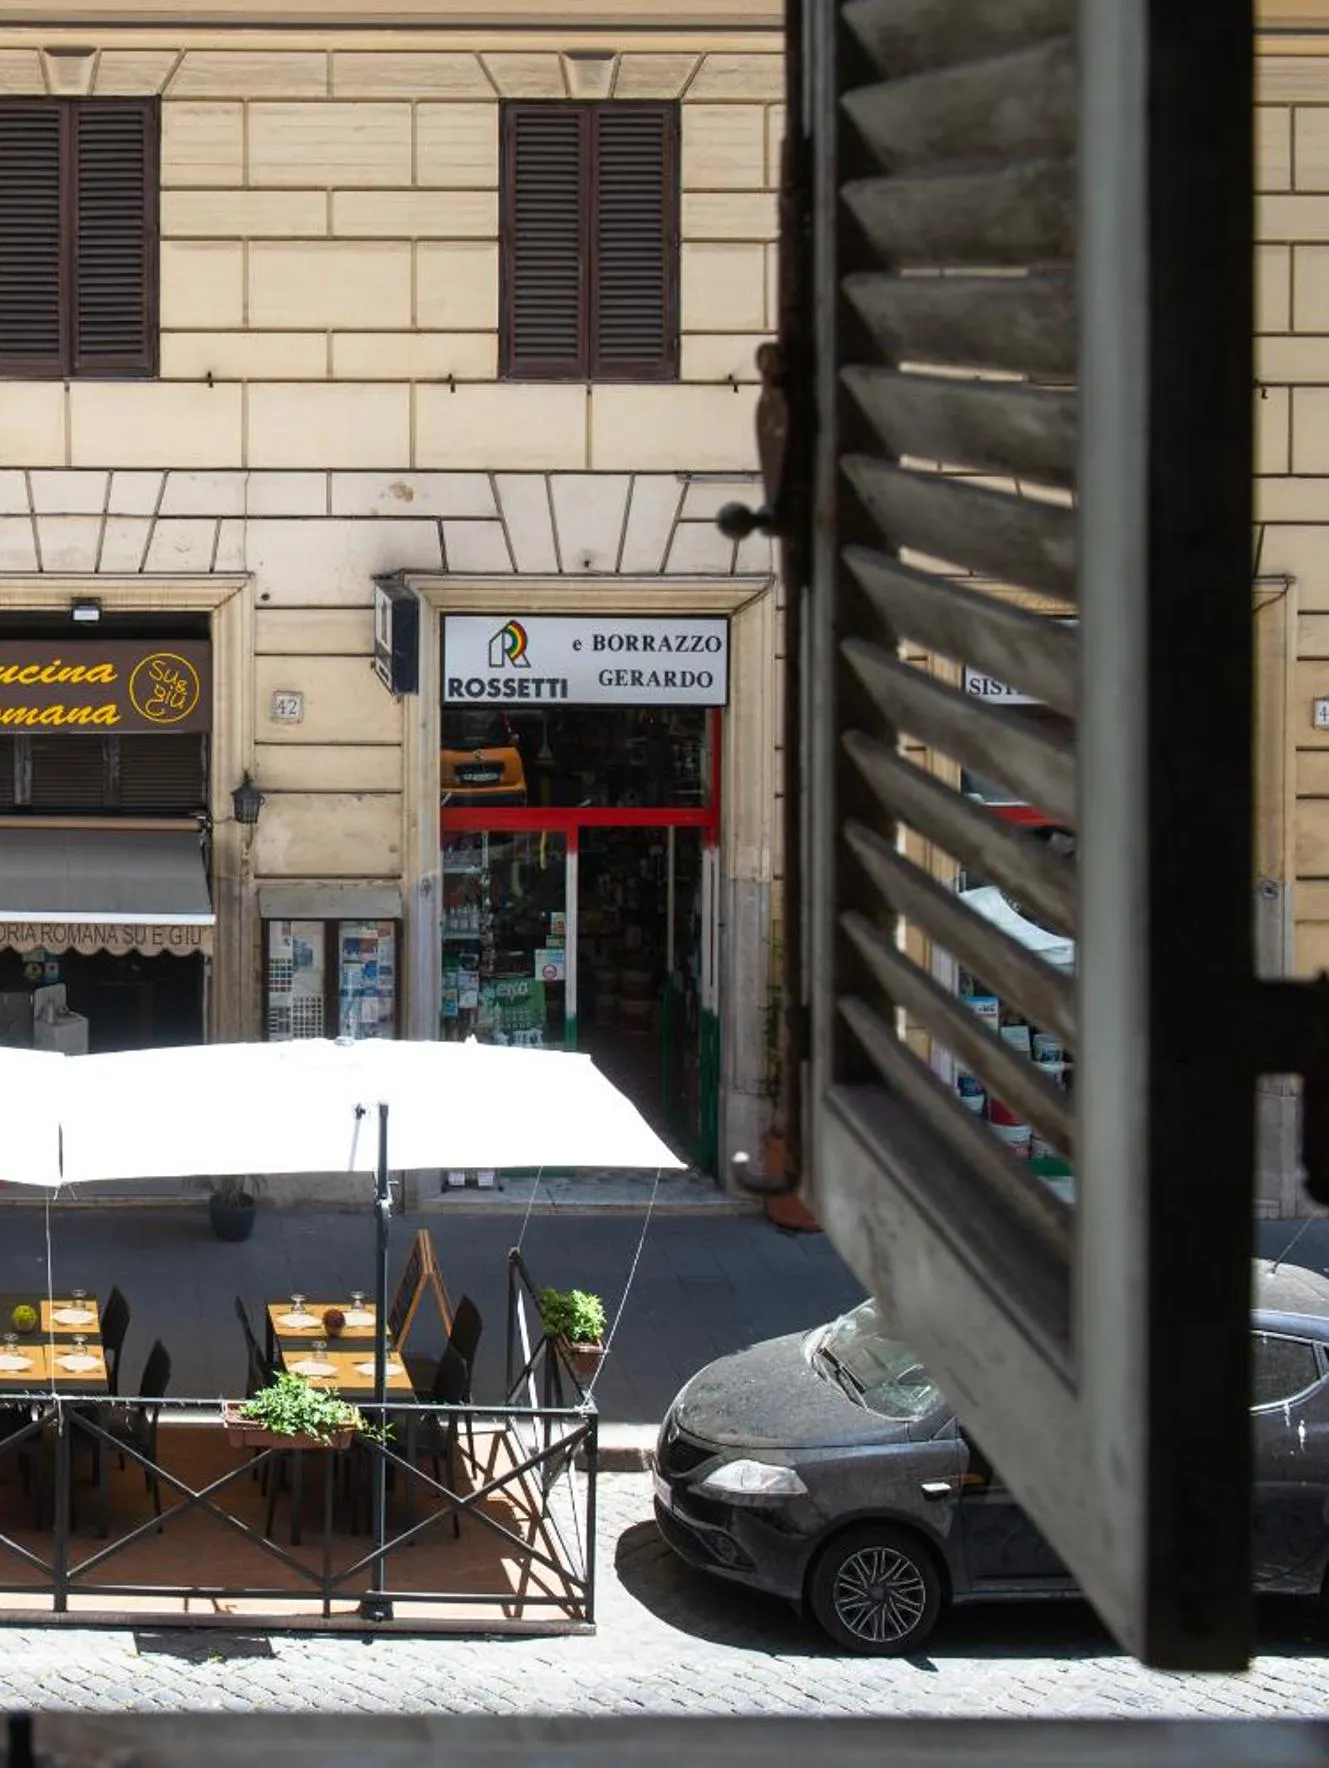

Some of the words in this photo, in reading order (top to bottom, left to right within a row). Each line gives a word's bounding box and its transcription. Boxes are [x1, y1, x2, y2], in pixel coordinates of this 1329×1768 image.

[572, 639, 582, 651] e
[592, 634, 722, 653] BORRAZZO
[447, 677, 569, 698] ROSSETTI
[598, 669, 714, 688] GERARDO
[277, 699, 297, 715] 42
[40, 923, 119, 944] ROMANA
[123, 925, 147, 945] SU
[152, 925, 163, 945] E
